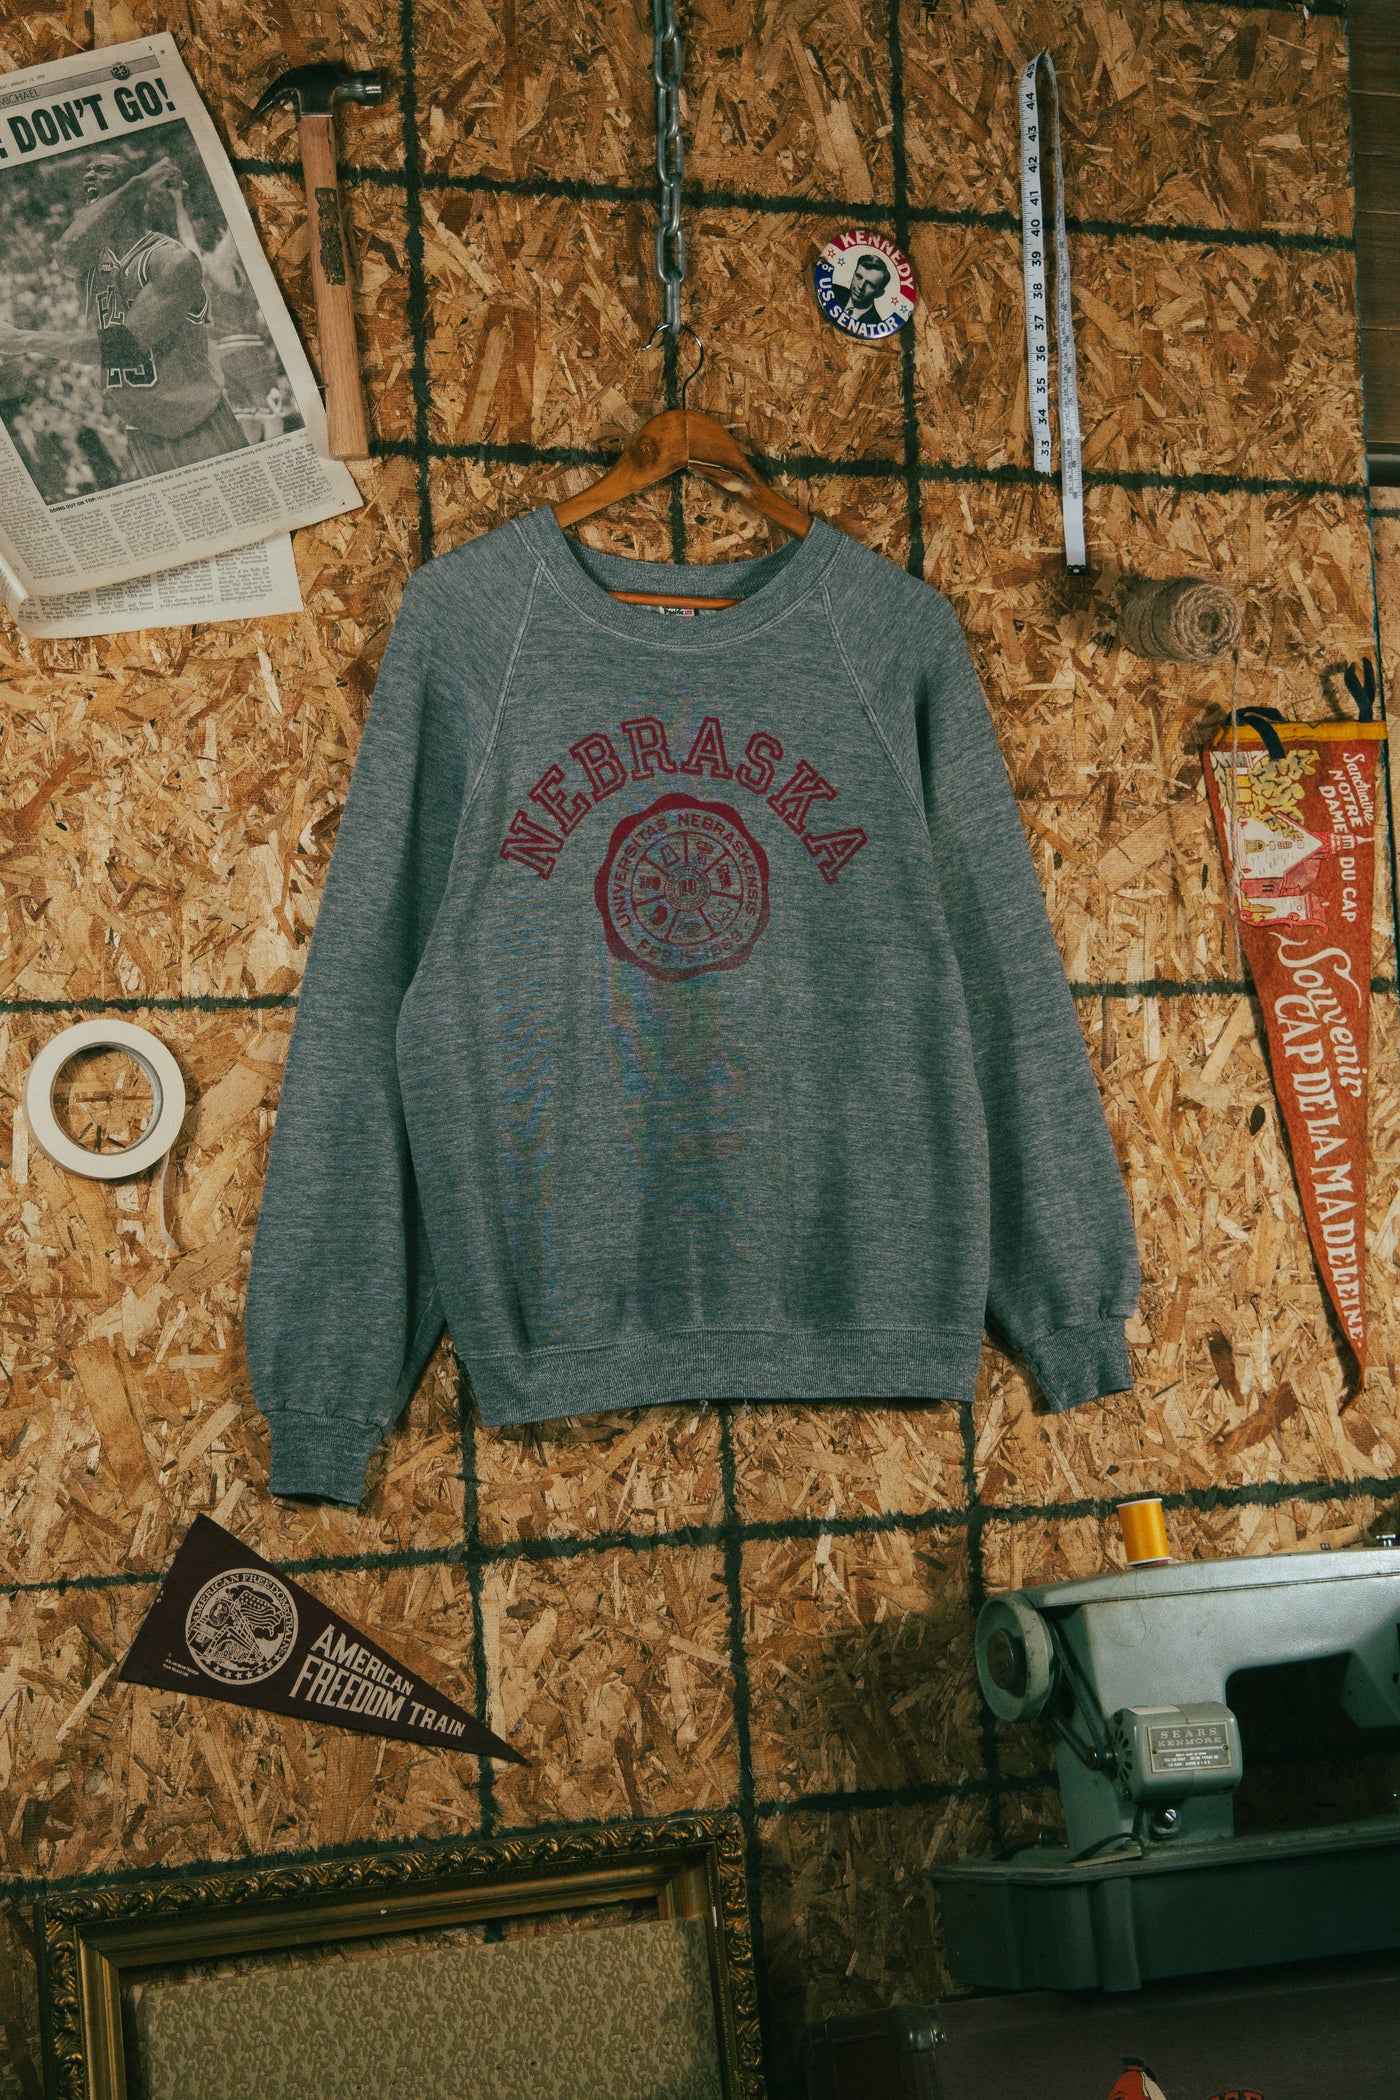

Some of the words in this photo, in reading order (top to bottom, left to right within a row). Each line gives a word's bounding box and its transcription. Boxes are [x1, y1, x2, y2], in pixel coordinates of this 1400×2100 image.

[112, 64, 128, 77] 23
[1026, 63, 1035, 79] 45
[1027, 92, 1035, 110] 44
[7, 93, 109, 154] DON'T
[113, 77, 176, 123] GO!
[1029, 125, 1037, 142] 43
[1029, 156, 1038, 173] 42
[1029, 190, 1039, 206] 41
[1031, 219, 1041, 237] 40
[840, 230, 914, 290] KENNEDY
[1032, 251, 1042, 266] 39
[1033, 282, 1043, 299] 38
[829, 305, 899, 338] SENATOR
[1035, 315, 1045, 330] 37
[1036, 345, 1046, 361] 36
[1036, 378, 1046, 394] 35
[1038, 409, 1047, 425] 34
[1041, 439, 1050, 456] 33
[1072, 491, 1077, 499] 60
[1328, 769, 1363, 828] NOTRE
[1343, 752, 1374, 824] Sanctuaire
[500, 716, 868, 885] NEBRASKA
[1319, 785, 1349, 833] DAME
[613, 818, 668, 929] UNIVERSITAS
[677, 813, 759, 916] NEBRASKENSIS
[1339, 857, 1356, 881] DU
[1340, 887, 1357, 923] CAP
[1268, 931, 1368, 1100] Souvenir
[1273, 994, 1323, 1076] CAP
[1290, 1071, 1329, 1113] DE
[1305, 1108, 1348, 1162] LA
[192, 1574, 240, 1620] AMERICAN
[241, 1573, 288, 1609] FREEDOM
[283, 1611, 294, 1653] TRAIN
[310, 1624, 415, 1697] AMERICAN
[289, 1654, 402, 1722] FREEDOM
[408, 1701, 466, 1737] TRAIN
[1158, 1737, 1221, 1747] KENMORE
[1160, 1728, 1217, 1739] SEARS
